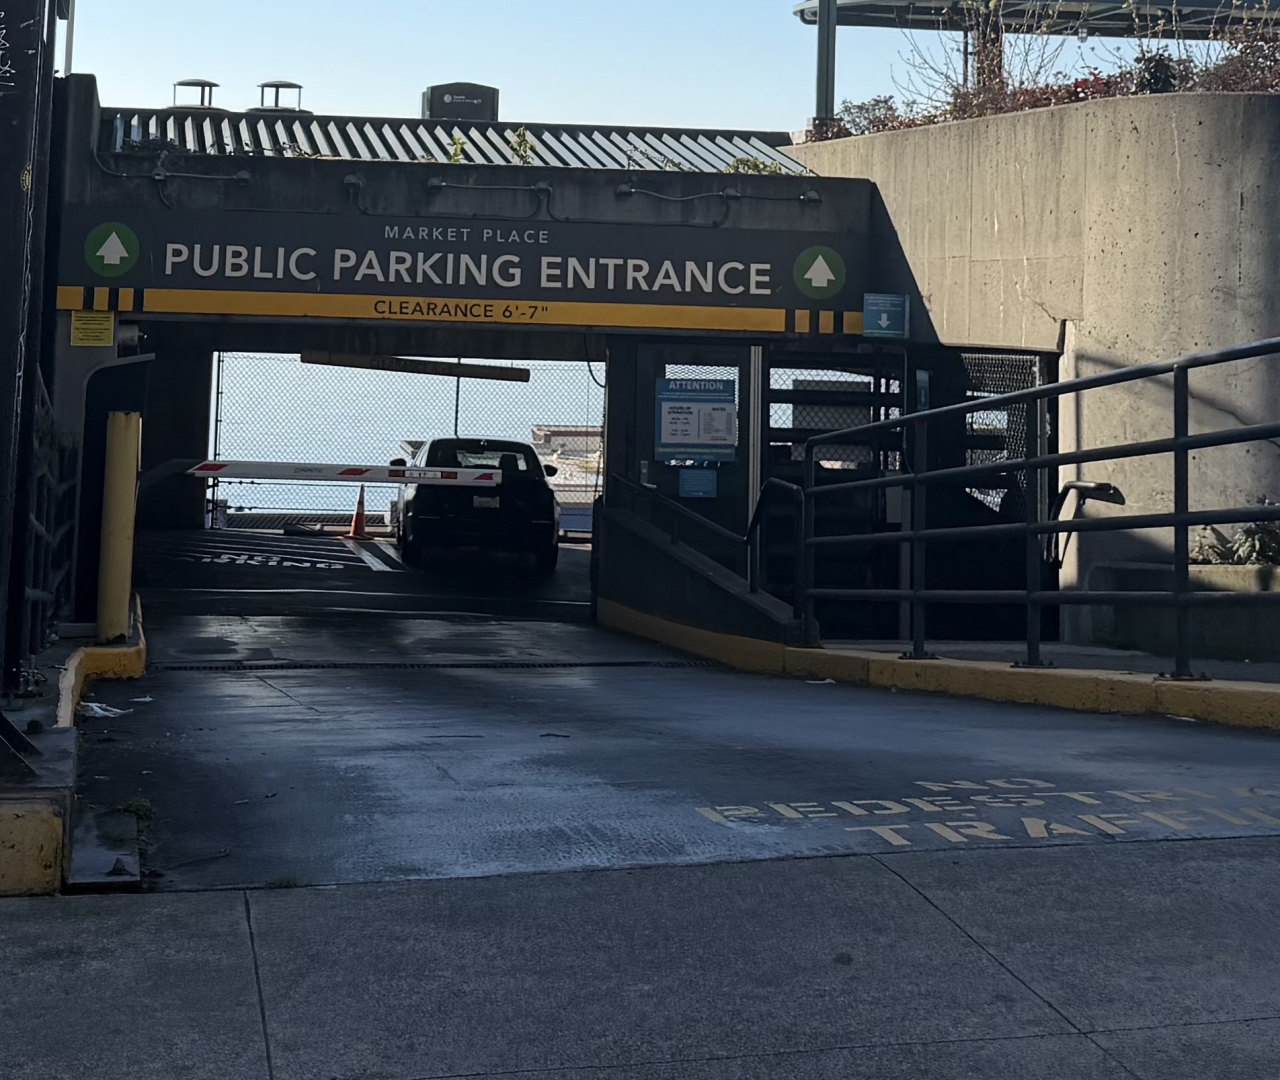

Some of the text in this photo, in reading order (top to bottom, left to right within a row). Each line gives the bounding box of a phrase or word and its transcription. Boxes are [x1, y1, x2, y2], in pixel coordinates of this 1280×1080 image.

[384, 225, 549, 244] MARKET PLACE
[164, 242, 772, 296] PUBLIC PARKING ENTRANCE
[373, 299, 549, 320] CLEARANCE 6'-7"
[668, 380, 724, 390] ATTENTION
[913, 778, 1057, 791] NO
